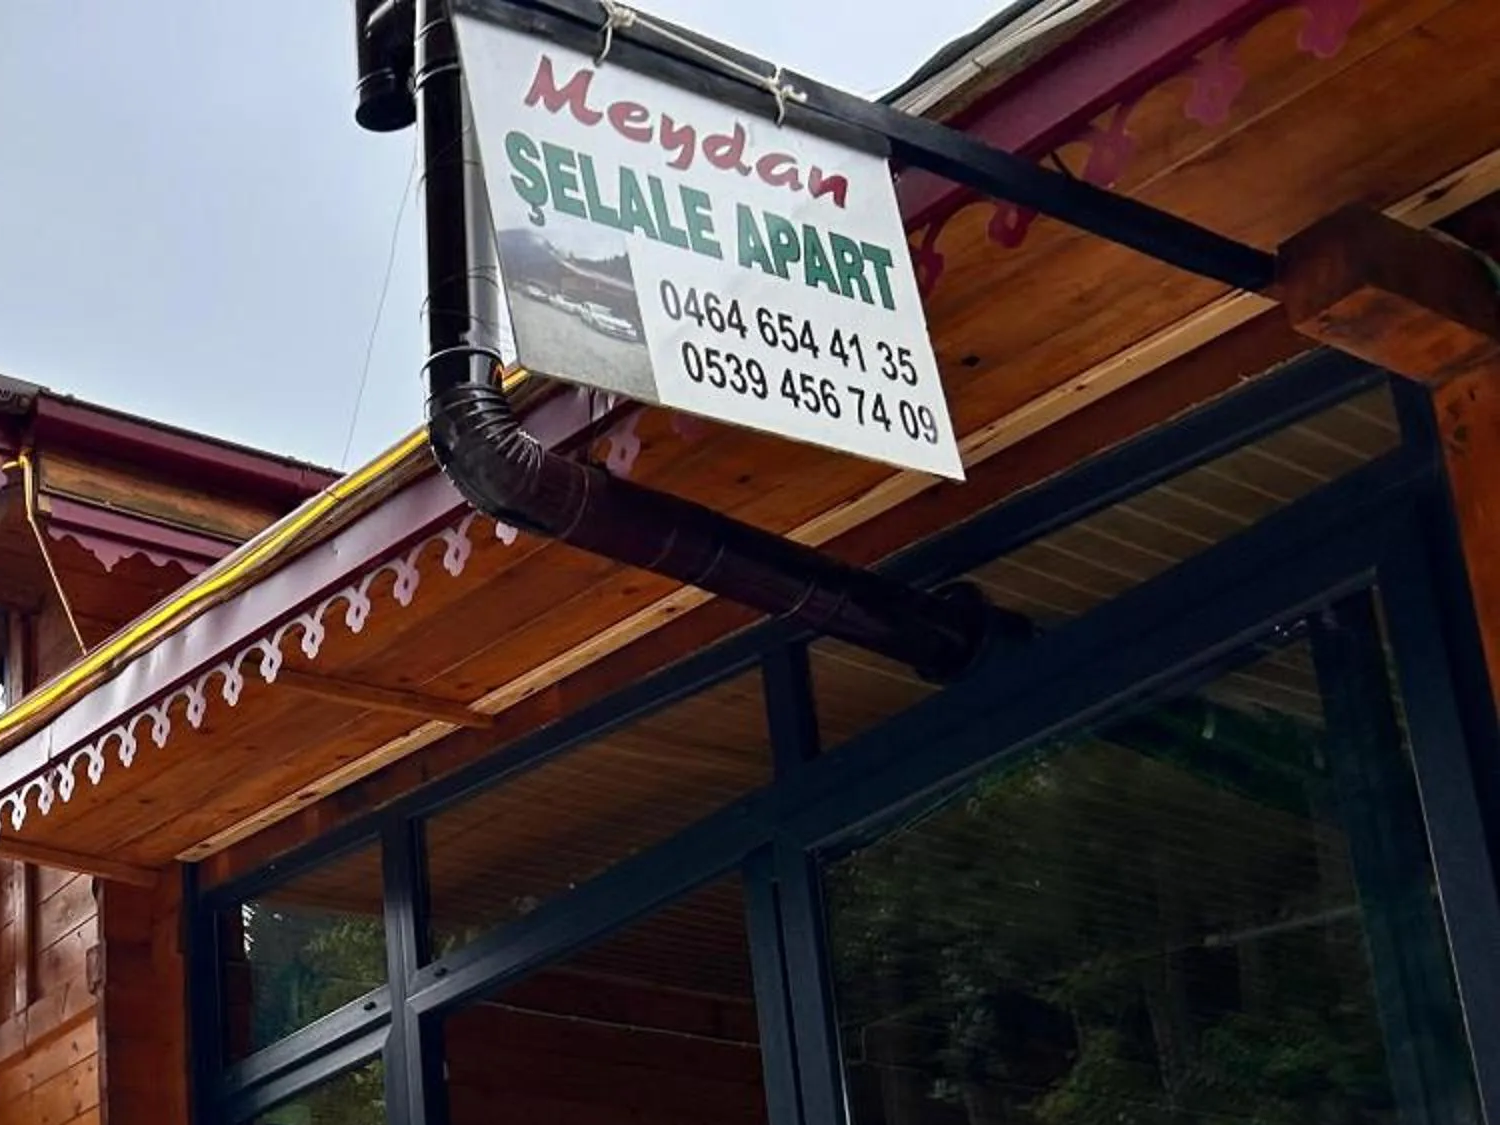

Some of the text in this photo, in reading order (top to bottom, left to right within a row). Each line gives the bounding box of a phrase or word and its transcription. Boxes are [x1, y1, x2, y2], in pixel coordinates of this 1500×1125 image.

[523, 54, 849, 209] Meydan
[504, 130, 896, 311] ŞELALE APART
[659, 279, 918, 387] 0464 654 41 35
[682, 341, 939, 445] 0539 456 74 09
